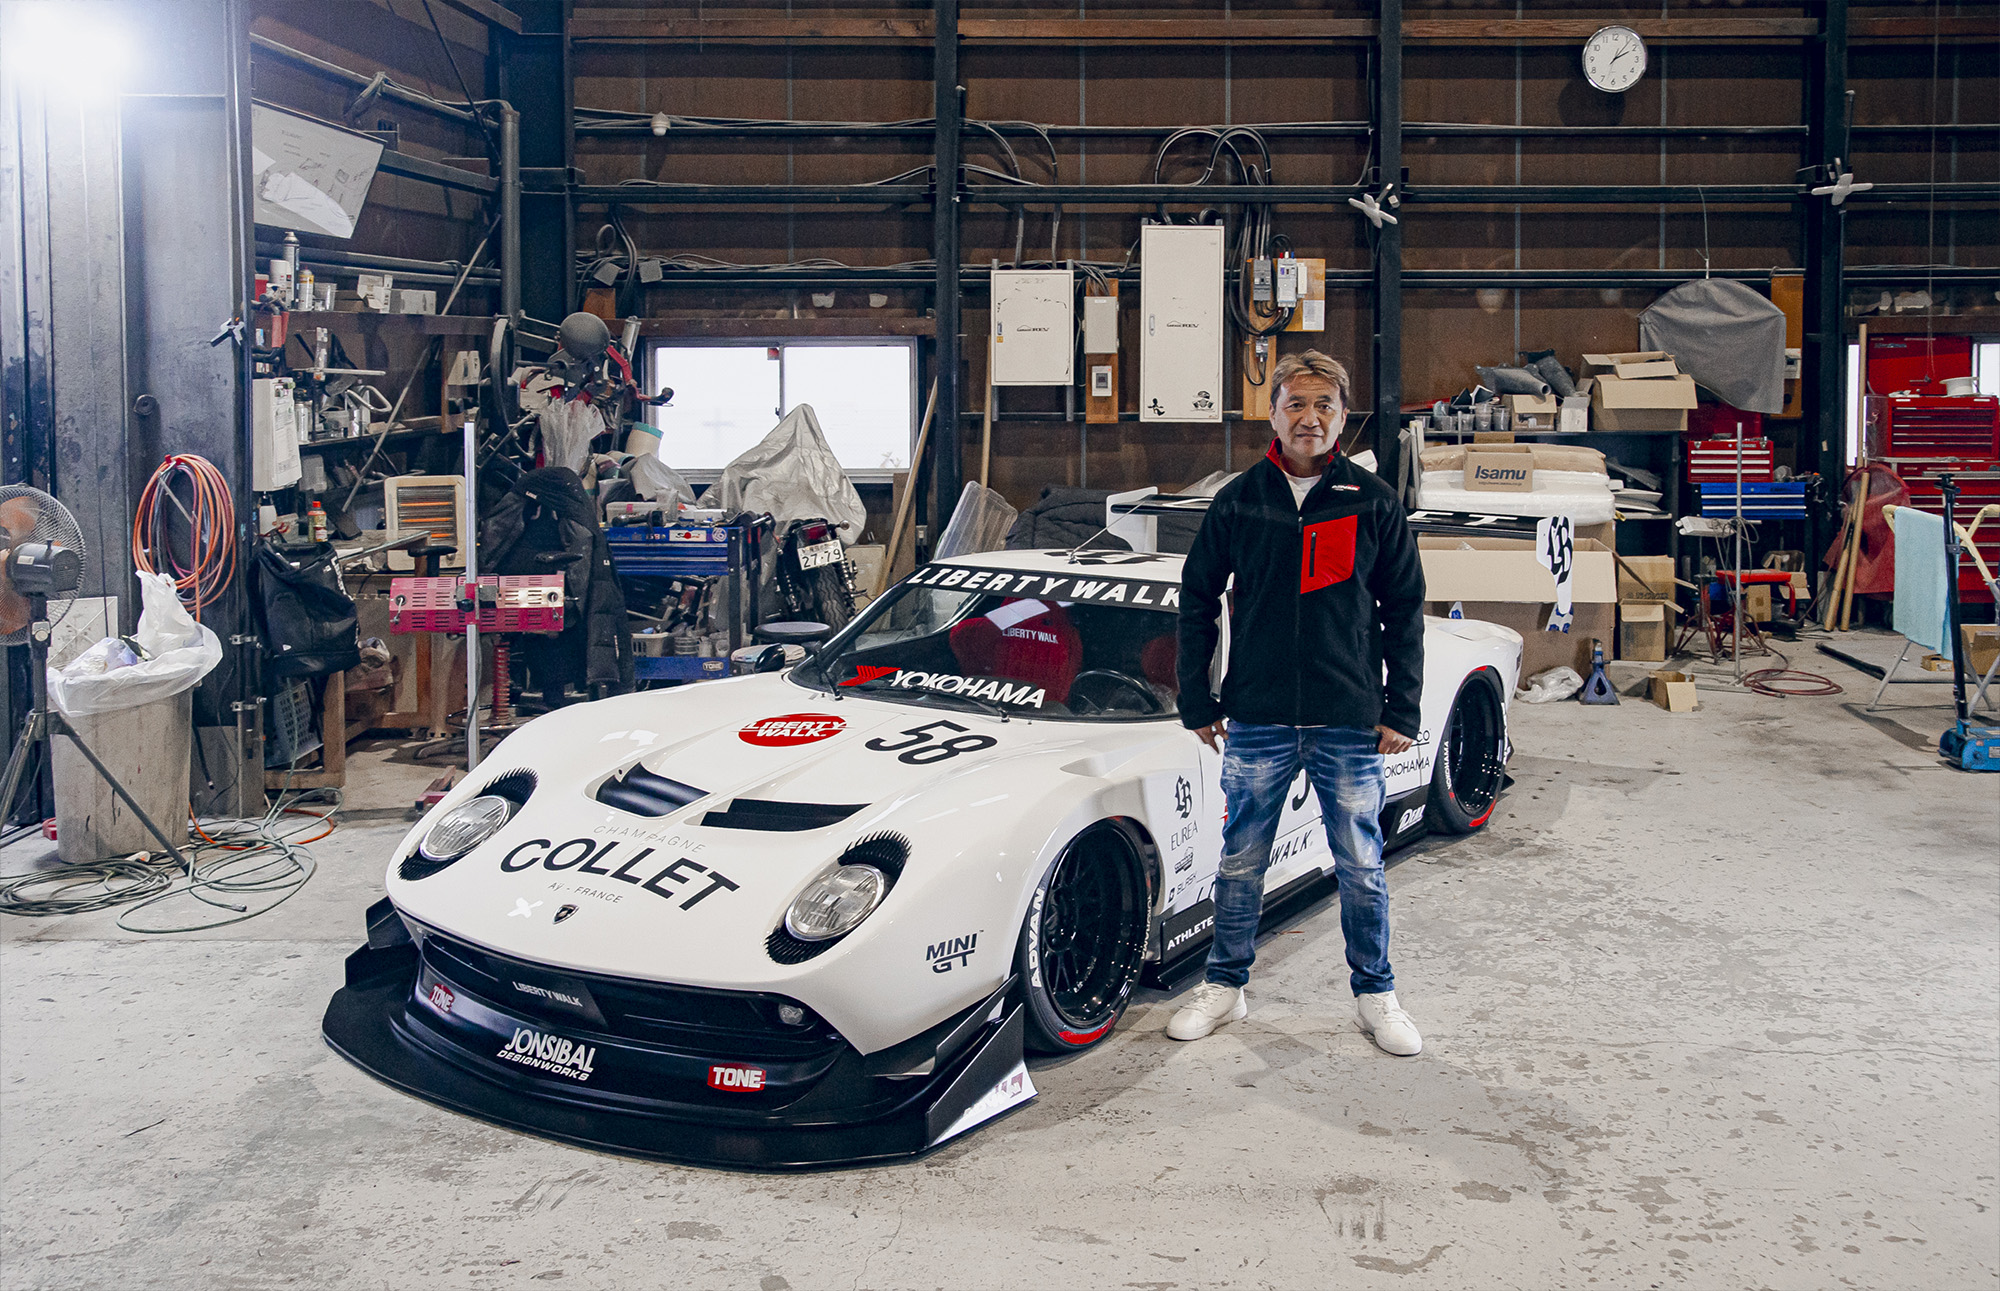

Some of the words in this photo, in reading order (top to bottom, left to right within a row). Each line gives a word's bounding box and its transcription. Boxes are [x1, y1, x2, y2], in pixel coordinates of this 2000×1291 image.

[1612, 33, 1619, 41] 12
[1475, 465, 1527, 480] Isamu
[907, 567, 1069, 595] LIBERTY
[1071, 580, 1180, 608] WALK
[1002, 628, 1036, 640] LIBERTY
[1038, 630, 1059, 644] WALK
[890, 670, 1046, 708] YOKOHAMA
[744, 721, 848, 731] LIBERTY
[865, 719, 998, 765] 58
[1384, 756, 1431, 779] OKOHAMA
[1443, 741, 1452, 790] YOKOHAMA
[593, 825, 707, 853] CHAMPAGNE
[1171, 820, 1199, 851] EUREA
[500, 838, 741, 912] COLLET
[573, 885, 624, 904] FRANCE
[925, 932, 978, 961] MINI
[1028, 888, 1046, 988] ADVAN
[1167, 915, 1214, 951] ATHLETE
[932, 949, 976, 974] GT
[430, 985, 455, 1012] TONE
[512, 981, 552, 999] LIBERTY
[553, 990, 583, 1007] WALK
[504, 1027, 596, 1074] JONSIBAL
[496, 1050, 590, 1081] DESIGNWORKS
[713, 1066, 763, 1089] TONE
